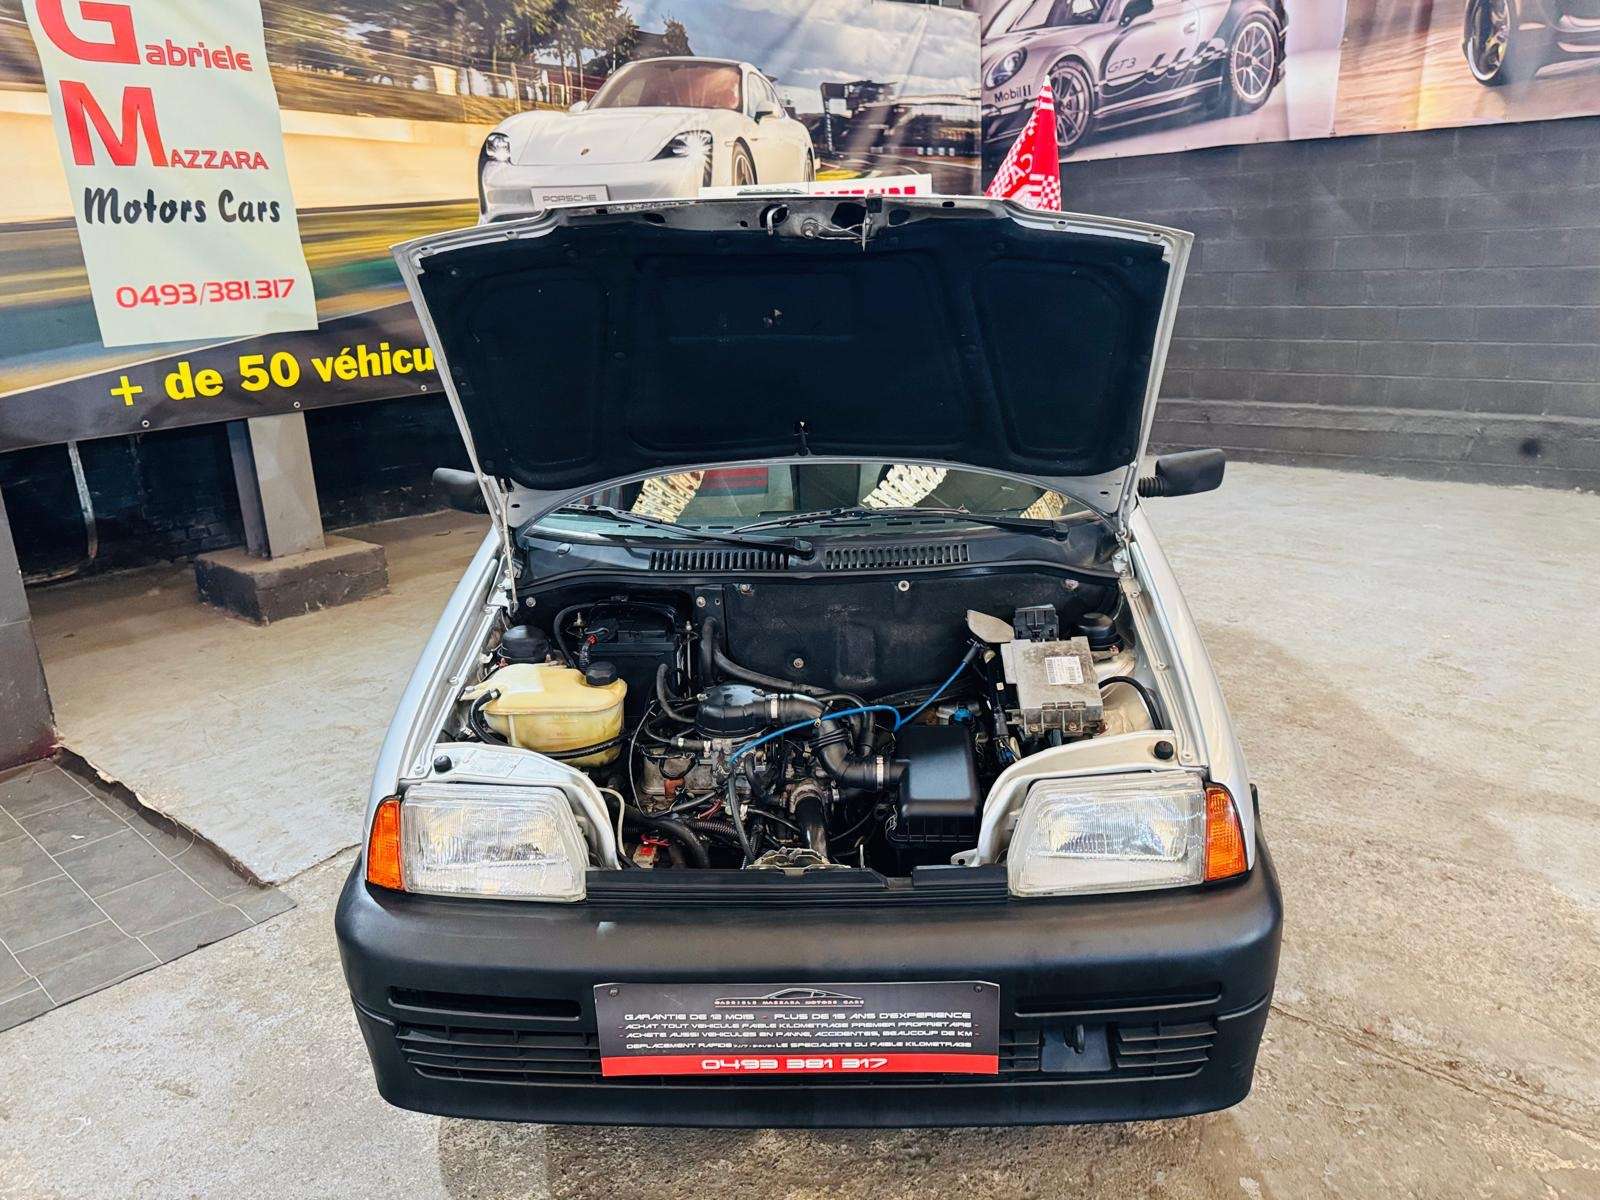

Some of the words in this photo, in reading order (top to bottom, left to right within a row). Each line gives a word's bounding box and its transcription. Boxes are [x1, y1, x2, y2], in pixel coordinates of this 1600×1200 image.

[59, 80, 269, 170] MAZZARA
[84, 187, 207, 225] Motors
[218, 189, 281, 223] Cars
[542, 194, 597, 203] PORSCHE
[115, 278, 295, 309] 0493/381.317
[164, 361, 223, 401] de
[238, 352, 300, 392] 50
[624, 1013, 687, 1021] GARANTIE
[849, 1012, 876, 1020] ANS
[701, 1058, 779, 1070] 0493
[786, 1058, 834, 1069] 381
[841, 1057, 889, 1069] 317
